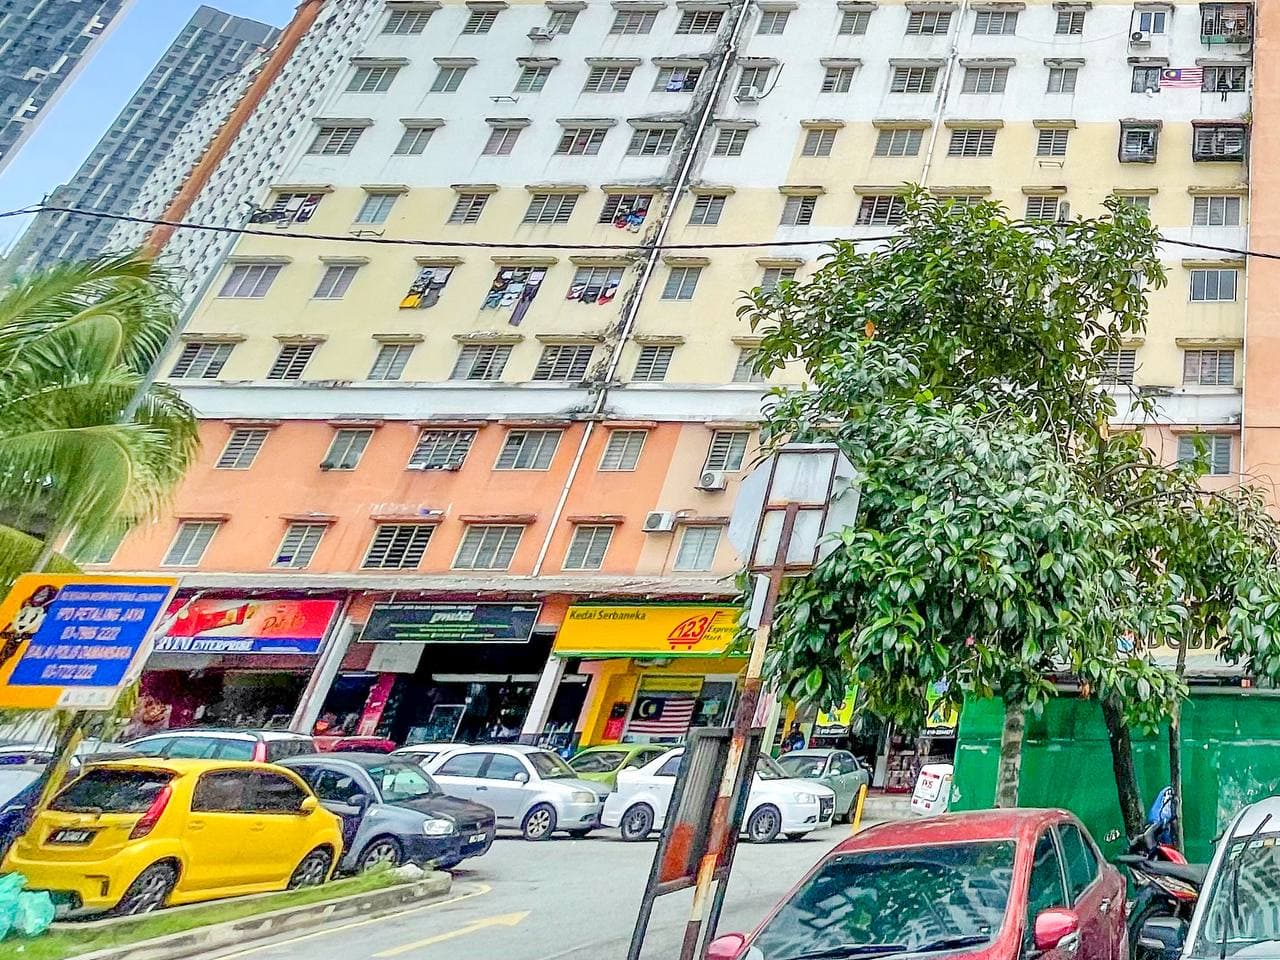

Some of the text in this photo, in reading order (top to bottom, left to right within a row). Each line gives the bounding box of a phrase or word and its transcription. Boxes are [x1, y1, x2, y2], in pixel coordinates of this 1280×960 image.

[73, 607, 123, 621] PETALING
[119, 607, 145, 621] JAYA
[569, 609, 647, 621] Kedai Serbaneka
[678, 616, 709, 638] 123
[190, 640, 254, 651] ENTERPRISE
